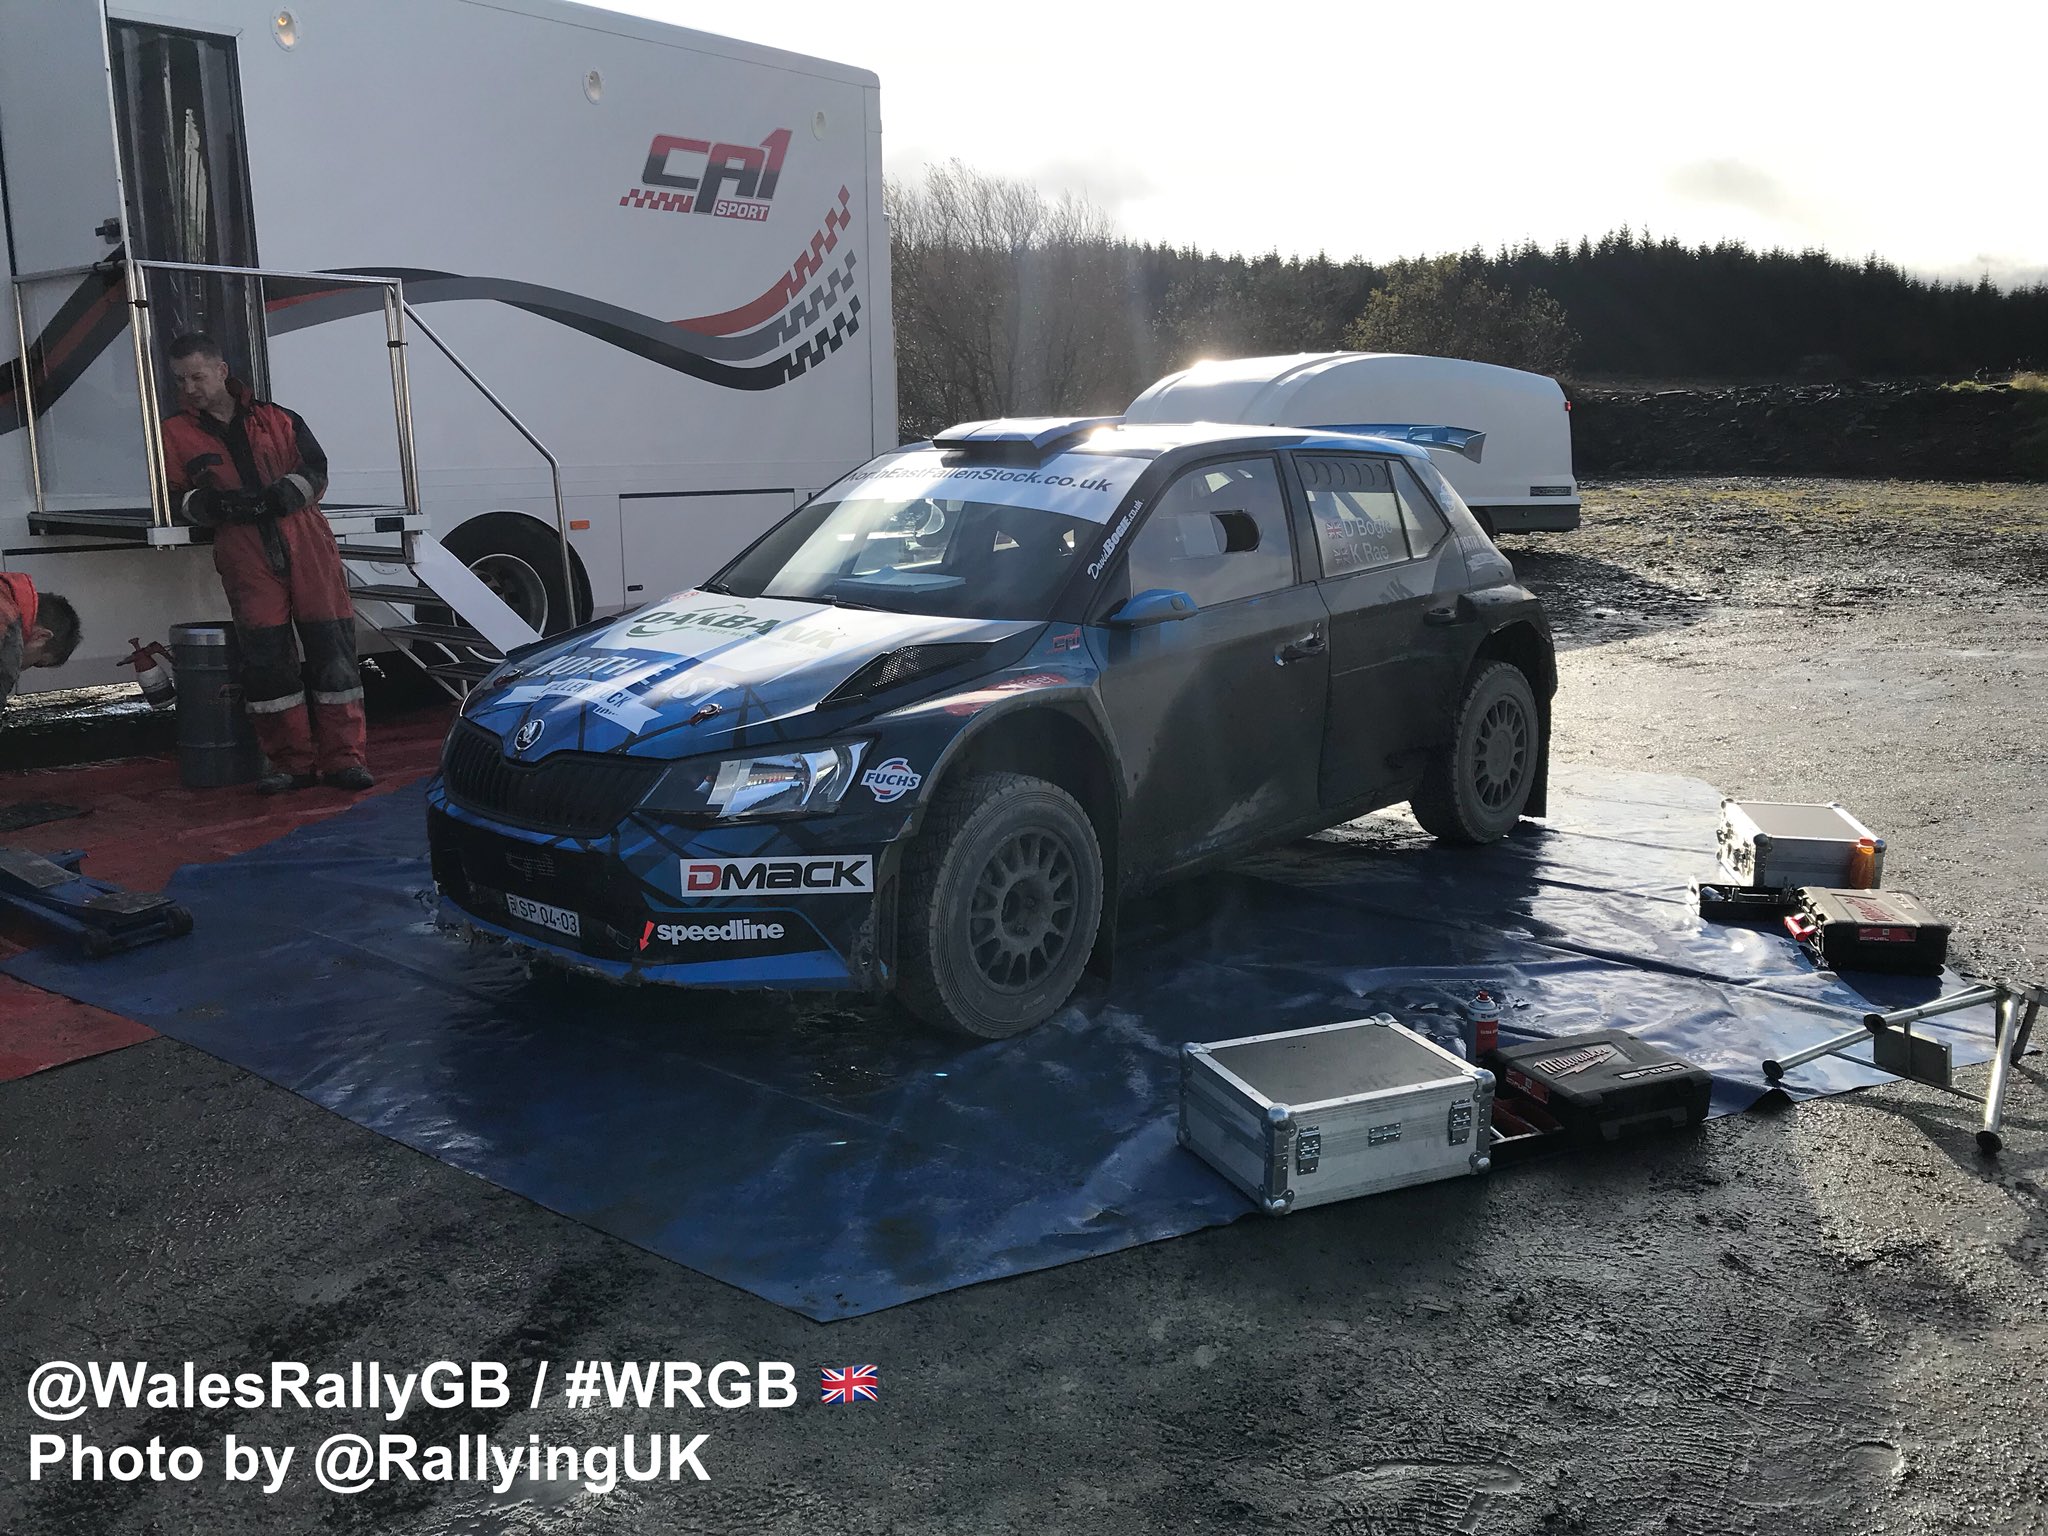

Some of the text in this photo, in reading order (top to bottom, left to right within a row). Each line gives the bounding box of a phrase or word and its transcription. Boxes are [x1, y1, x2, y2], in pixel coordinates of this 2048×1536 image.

[642, 128, 793, 214] CA1
[716, 202, 768, 220] SPORT
[1342, 517, 1393, 539] D Bogie
[1349, 542, 1390, 563] K Rae
[525, 655, 648, 677] NORTH
[541, 681, 591, 693] FLLEN
[864, 771, 920, 788] FUCHS
[519, 900, 537, 919] SP
[540, 906, 577, 932] 04-03
[656, 919, 785, 945] speedline
[1532, 1047, 1611, 1075] Milwaukee
